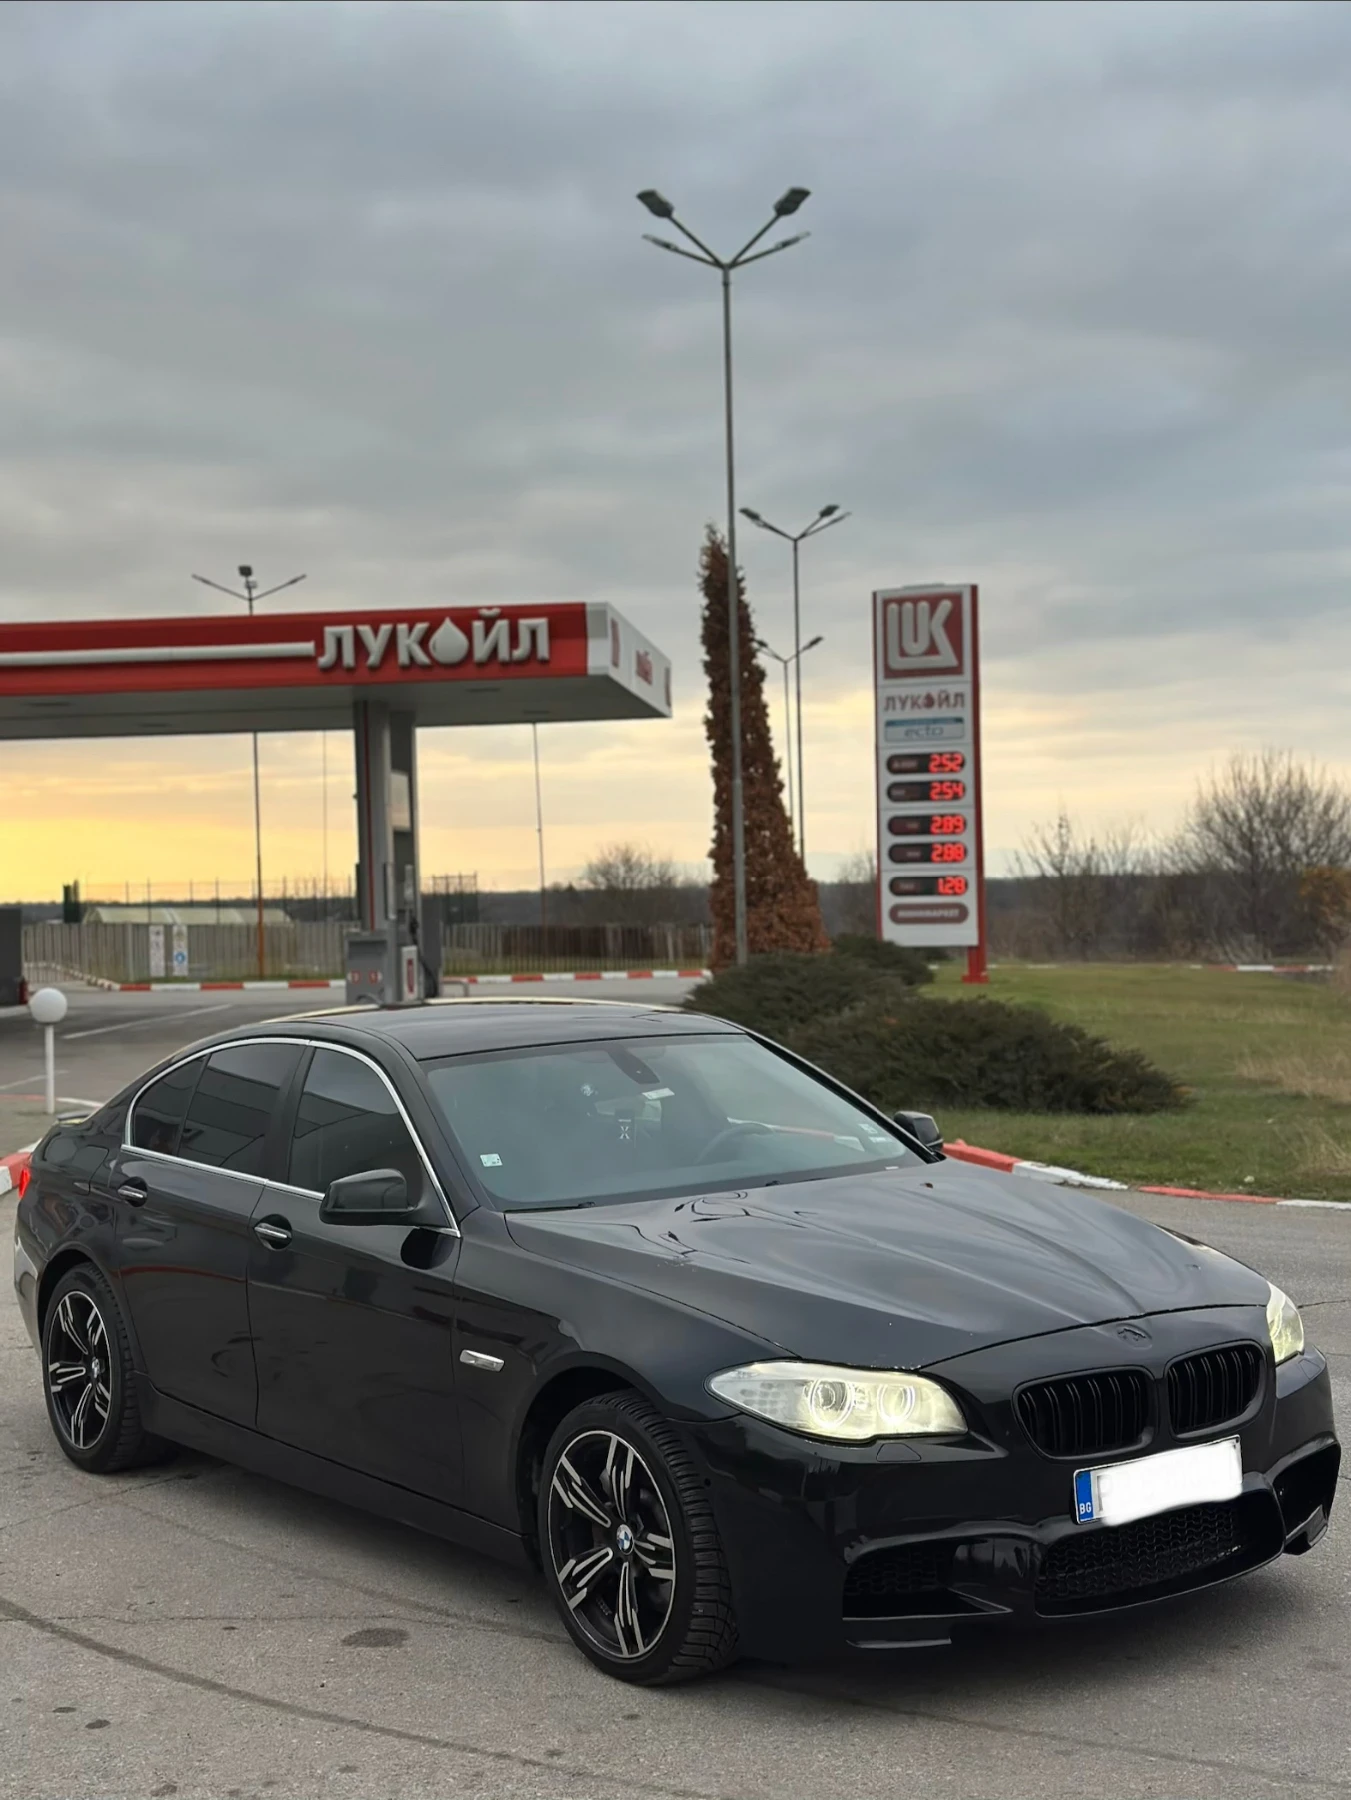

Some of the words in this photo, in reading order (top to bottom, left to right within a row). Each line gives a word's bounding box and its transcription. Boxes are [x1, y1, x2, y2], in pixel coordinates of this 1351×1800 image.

[318, 608, 549, 669] ЛУКОЙЛ
[884, 690, 965, 712] ЛУКОЙЛ
[1080, 1502, 1092, 1515] BG
